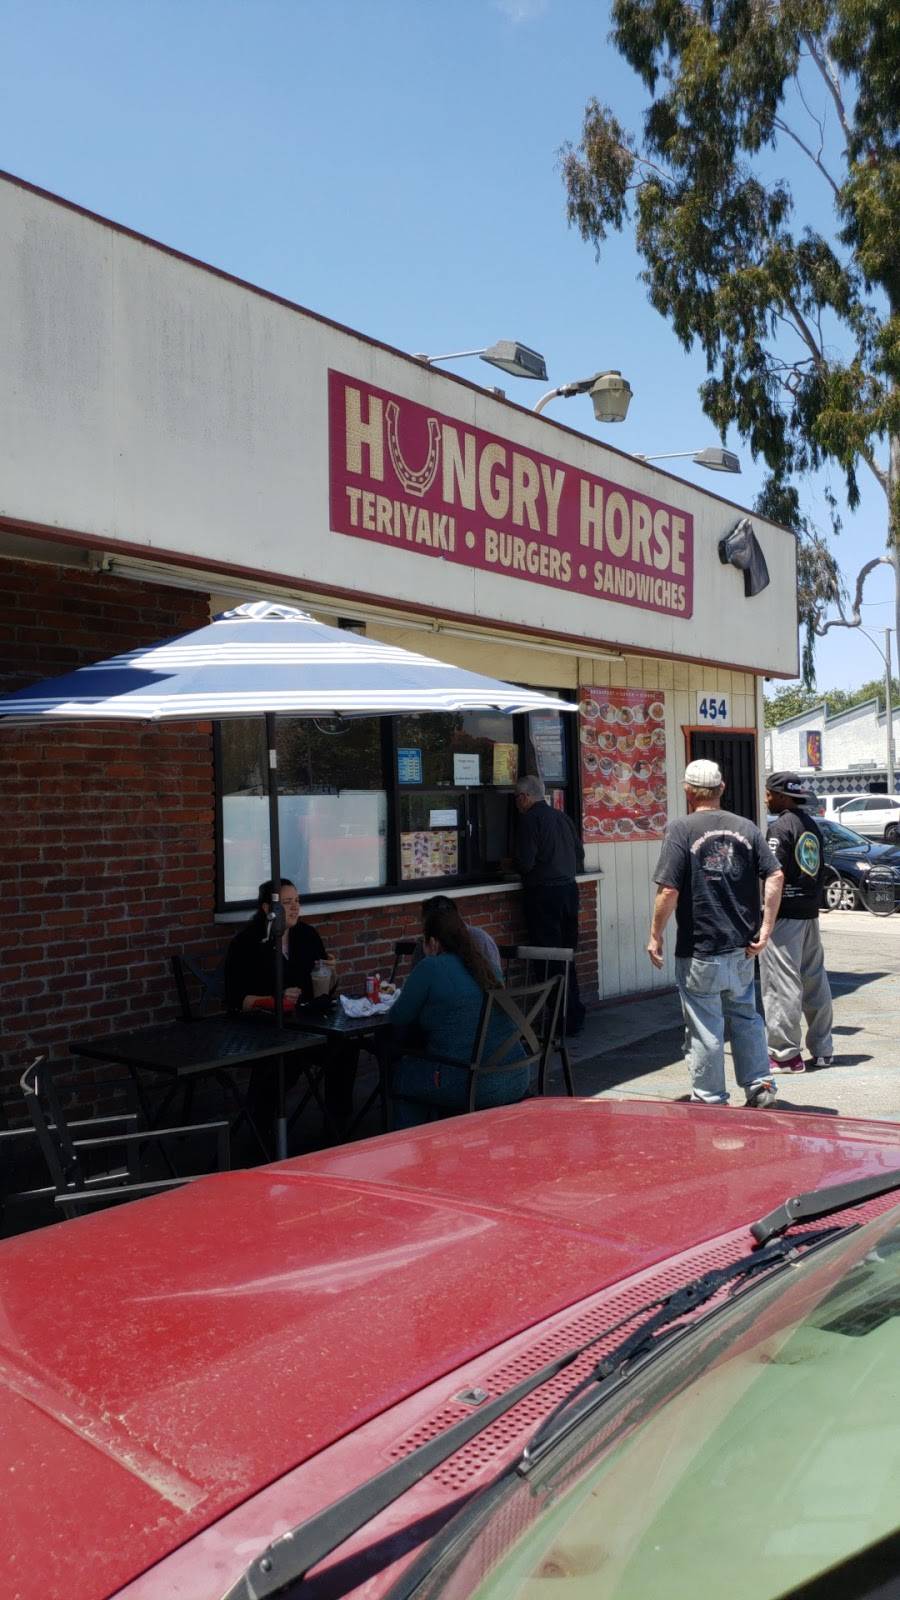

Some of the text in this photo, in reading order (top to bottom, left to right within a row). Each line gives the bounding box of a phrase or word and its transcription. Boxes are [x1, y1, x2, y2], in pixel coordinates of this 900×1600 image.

[345, 386, 686, 576] HUNGRY HORSE
[346, 486, 686, 611] TERIYAKI BURGERS SANDWICHES
[699, 698, 728, 720] 454
